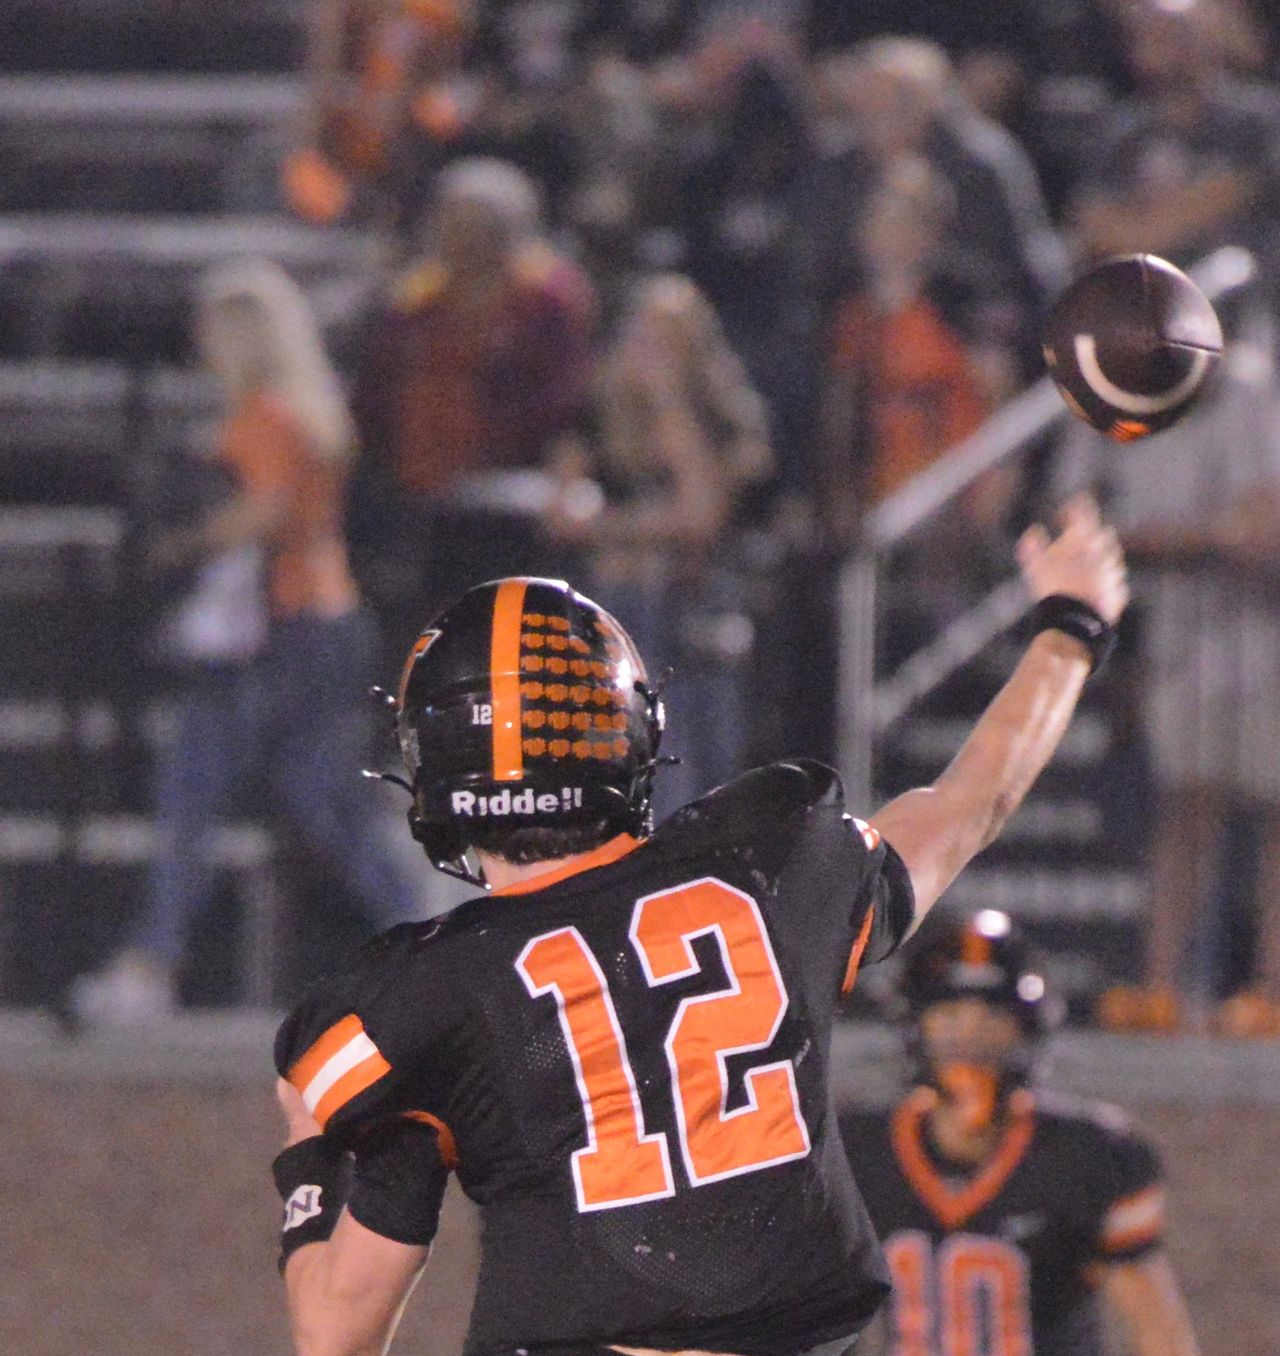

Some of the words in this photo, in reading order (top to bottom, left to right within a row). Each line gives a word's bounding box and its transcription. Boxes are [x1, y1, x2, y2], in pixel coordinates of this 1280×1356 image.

[472, 704, 493, 725] 12
[450, 786, 583, 817] Riddell
[513, 875, 812, 1213] 12
